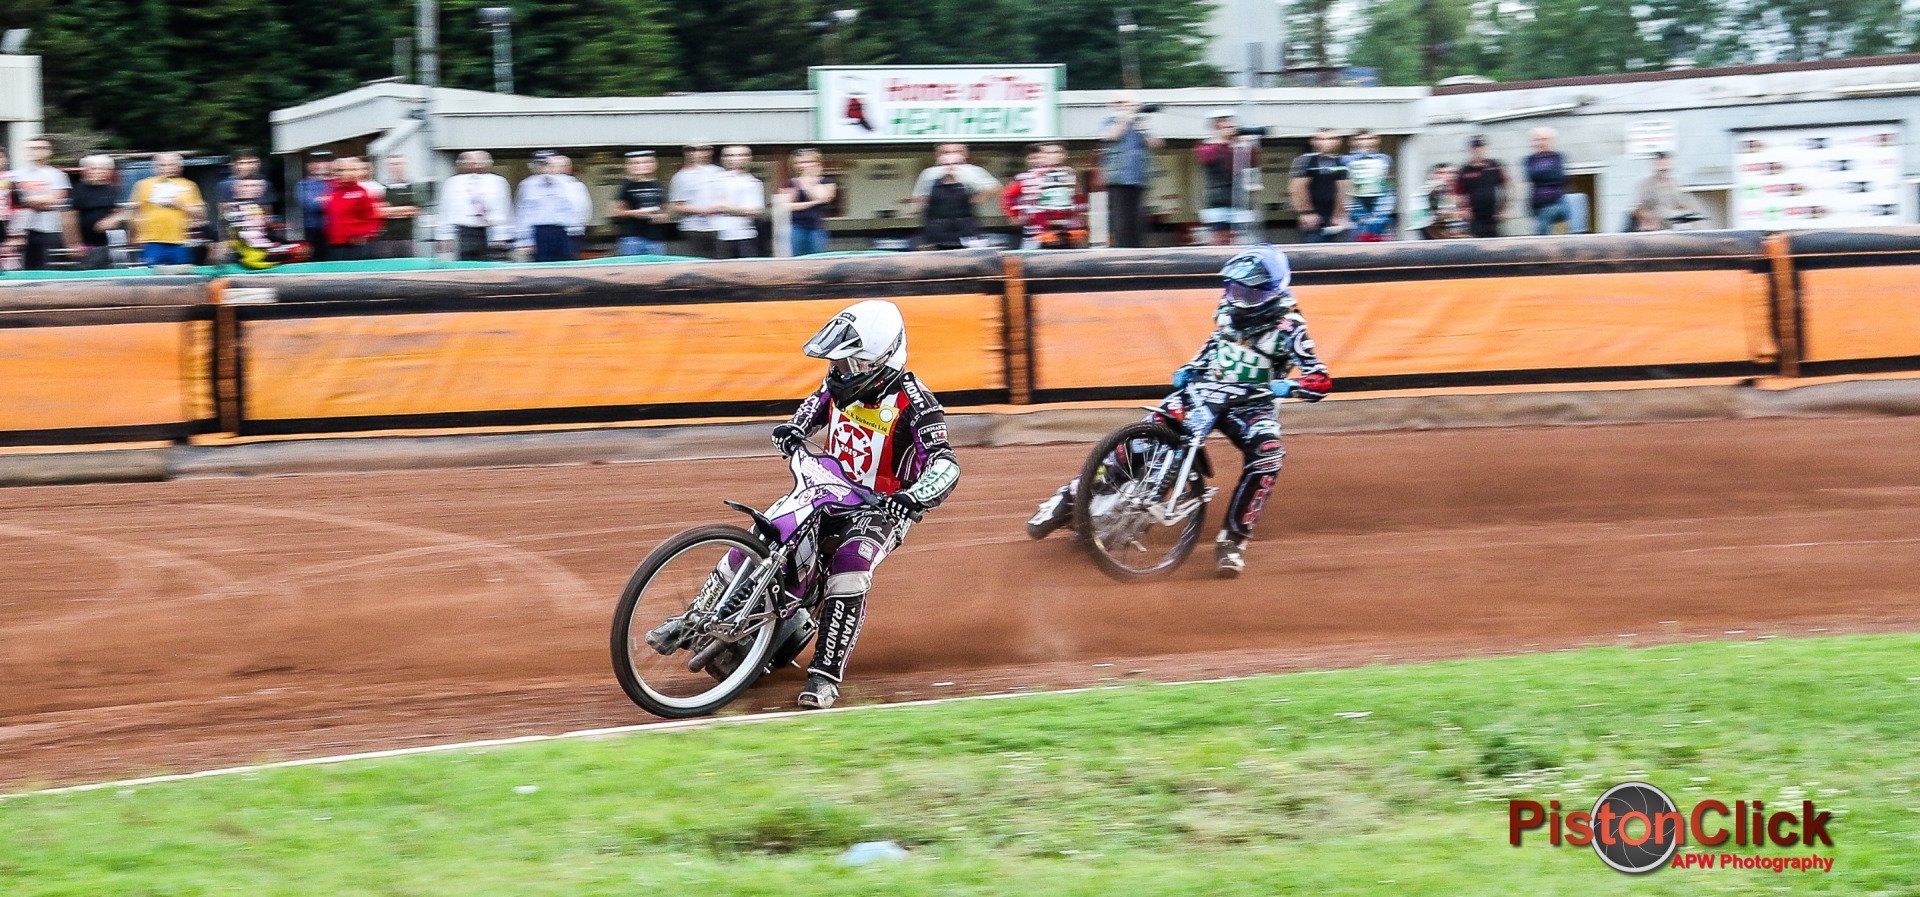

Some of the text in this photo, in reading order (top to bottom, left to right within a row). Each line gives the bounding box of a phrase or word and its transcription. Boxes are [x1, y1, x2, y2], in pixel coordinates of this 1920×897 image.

[882, 77, 960, 101] Home
[886, 107, 1038, 135] HEATHENS
[822, 599, 845, 667] GRANDPA
[840, 614, 856, 647] NAN
